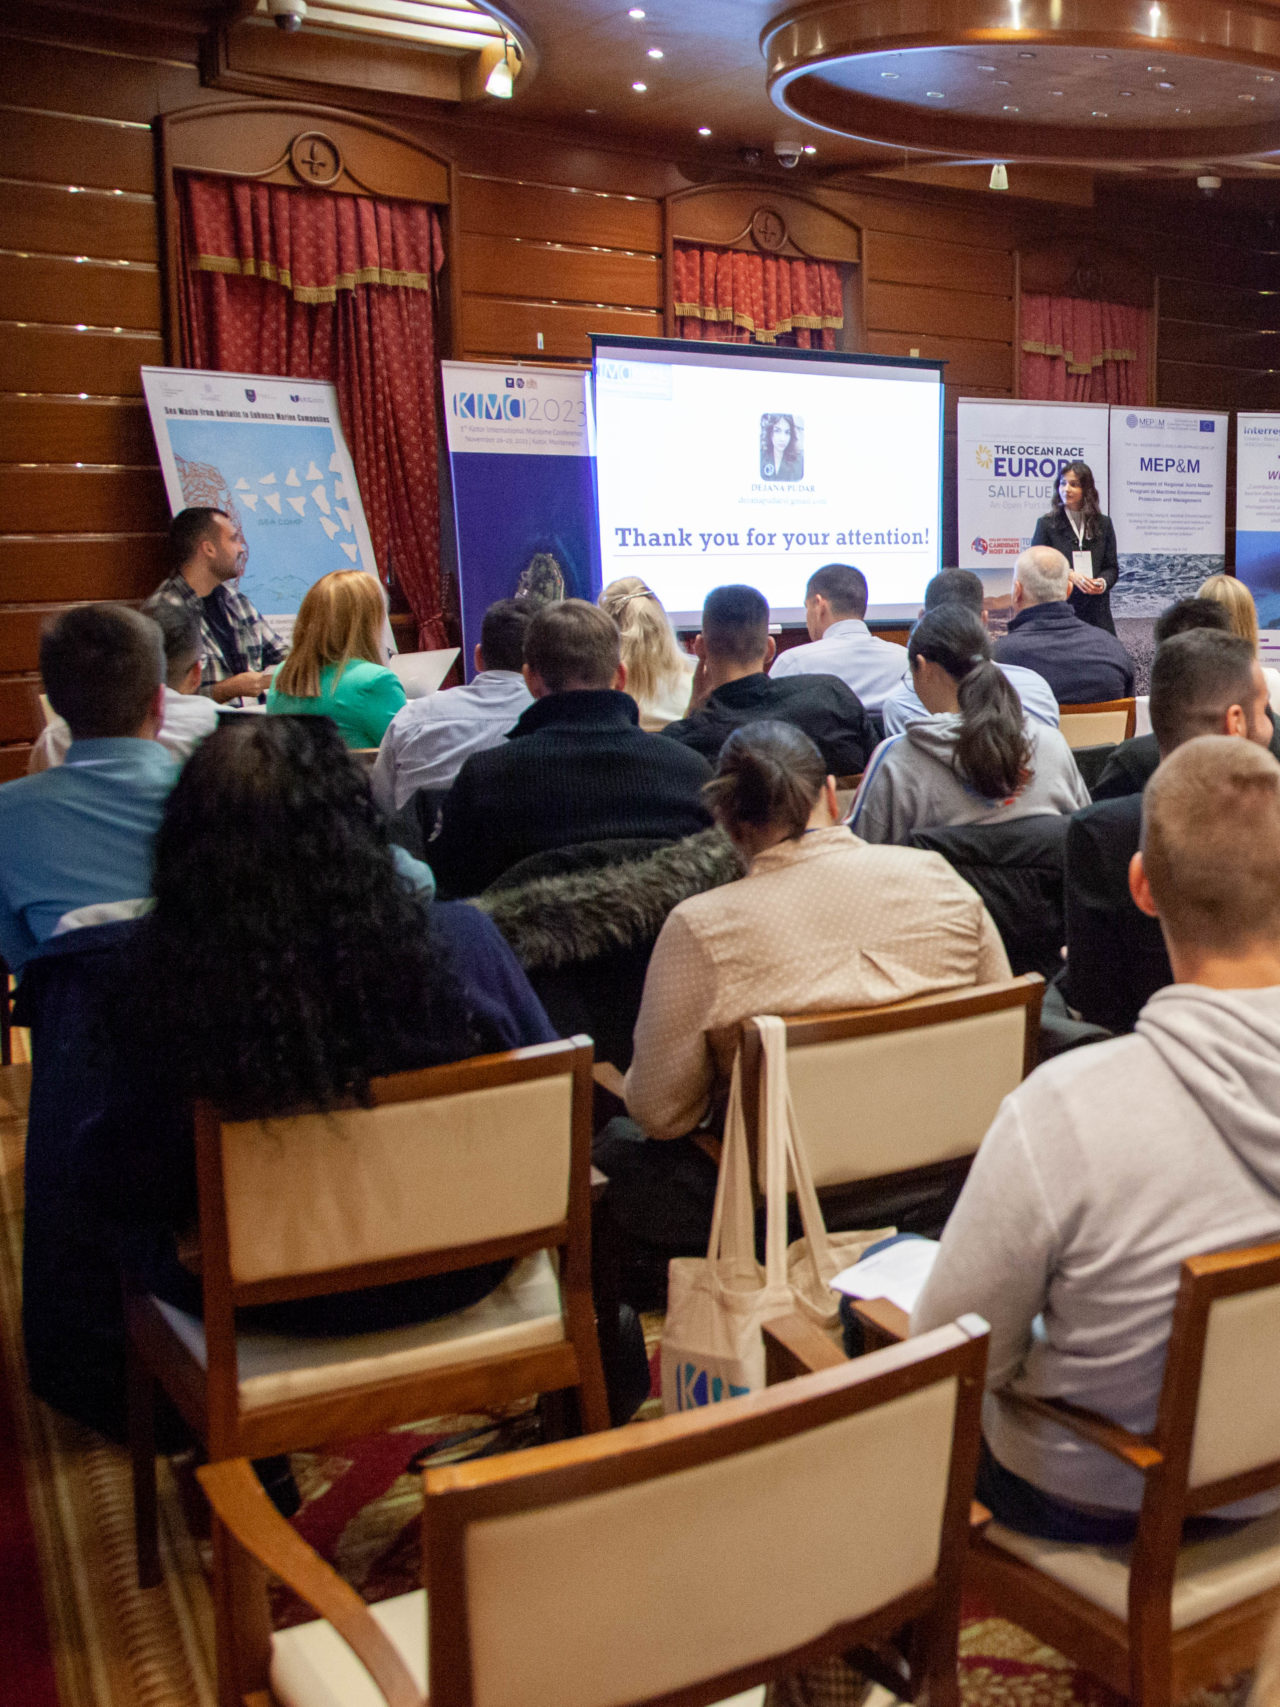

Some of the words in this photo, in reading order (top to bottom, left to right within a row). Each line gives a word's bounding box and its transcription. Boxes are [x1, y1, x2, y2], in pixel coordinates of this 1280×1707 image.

[165, 406, 177, 415] Sea
[178, 408, 198, 416] Waste
[200, 408, 214, 417] from
[216, 410, 241, 418] Adriatic
[250, 412, 274, 420] Enhance
[276, 413, 296, 421] Marine
[297, 414, 330, 423] Composites
[994, 445, 1016, 455] THE
[1018, 446, 1054, 456] OCEAN
[1056, 447, 1084, 457] RACE
[994, 458, 1084, 478] EUROP
[1140, 457, 1200, 473] MEP&M
[988, 485, 1052, 498] SAILFLUE
[615, 528, 692, 546] Thank
[699, 533, 740, 551] you
[746, 528, 776, 546] for
[783, 533, 830, 551] your
[836, 528, 929, 545] attention!
